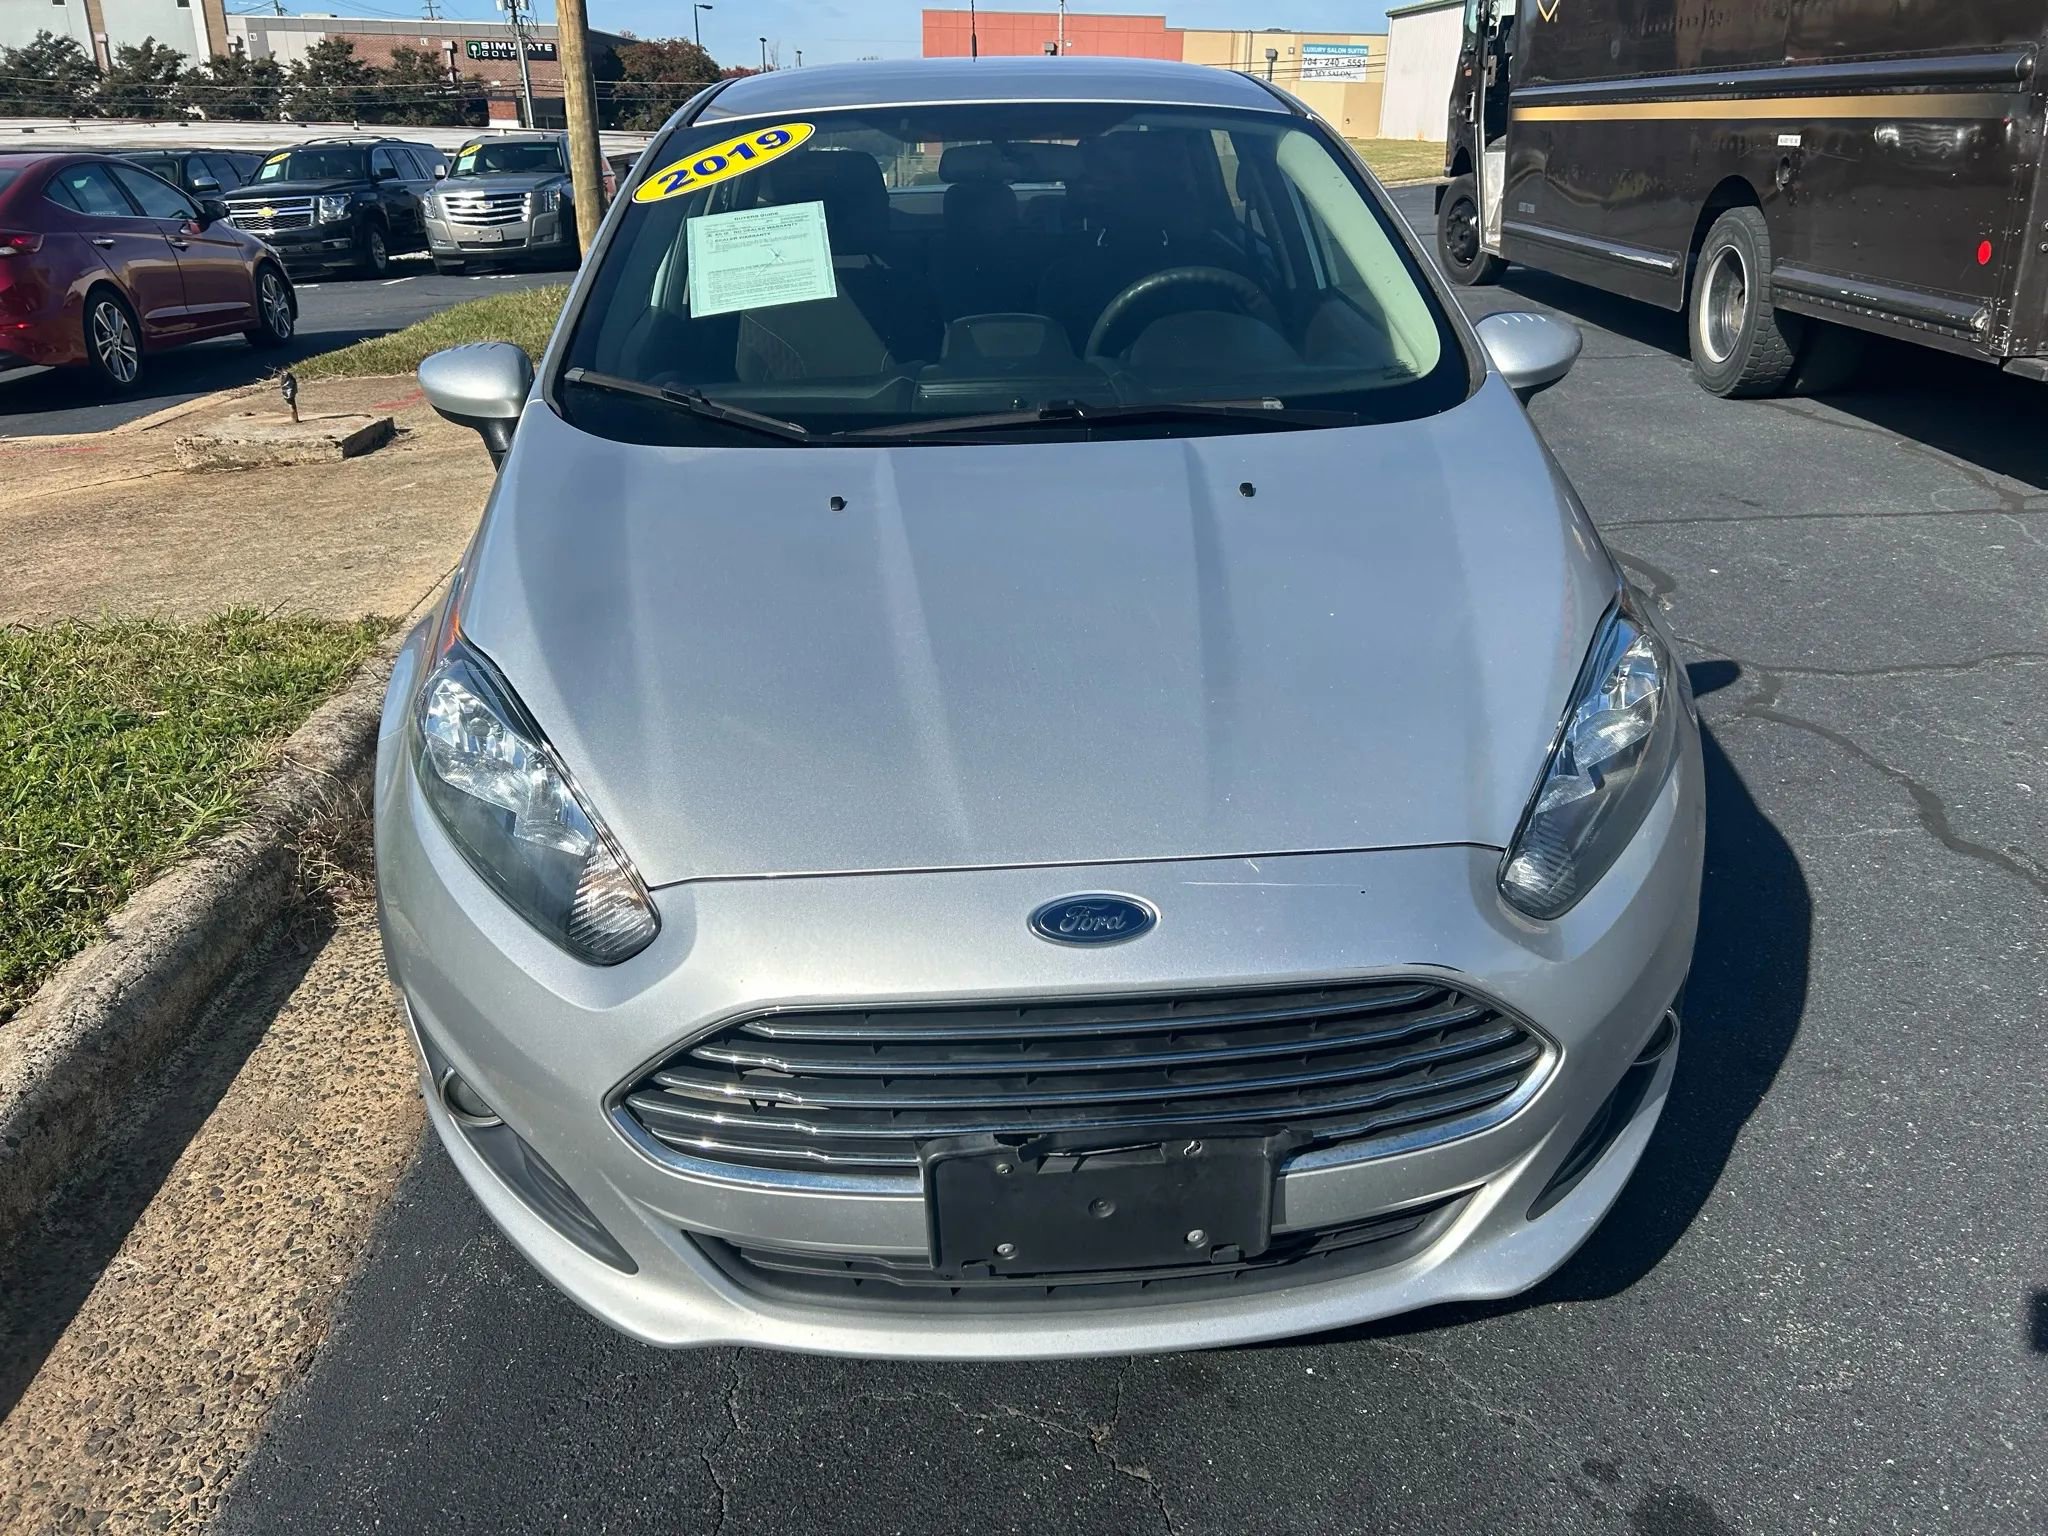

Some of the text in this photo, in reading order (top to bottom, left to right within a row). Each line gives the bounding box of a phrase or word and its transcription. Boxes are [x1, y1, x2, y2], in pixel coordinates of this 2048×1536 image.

[480, 42, 553, 52] SIMUATE
[1303, 46, 1326, 54] LUXURY
[657, 129, 793, 196] 2019
[1058, 904, 1127, 933] Ford
